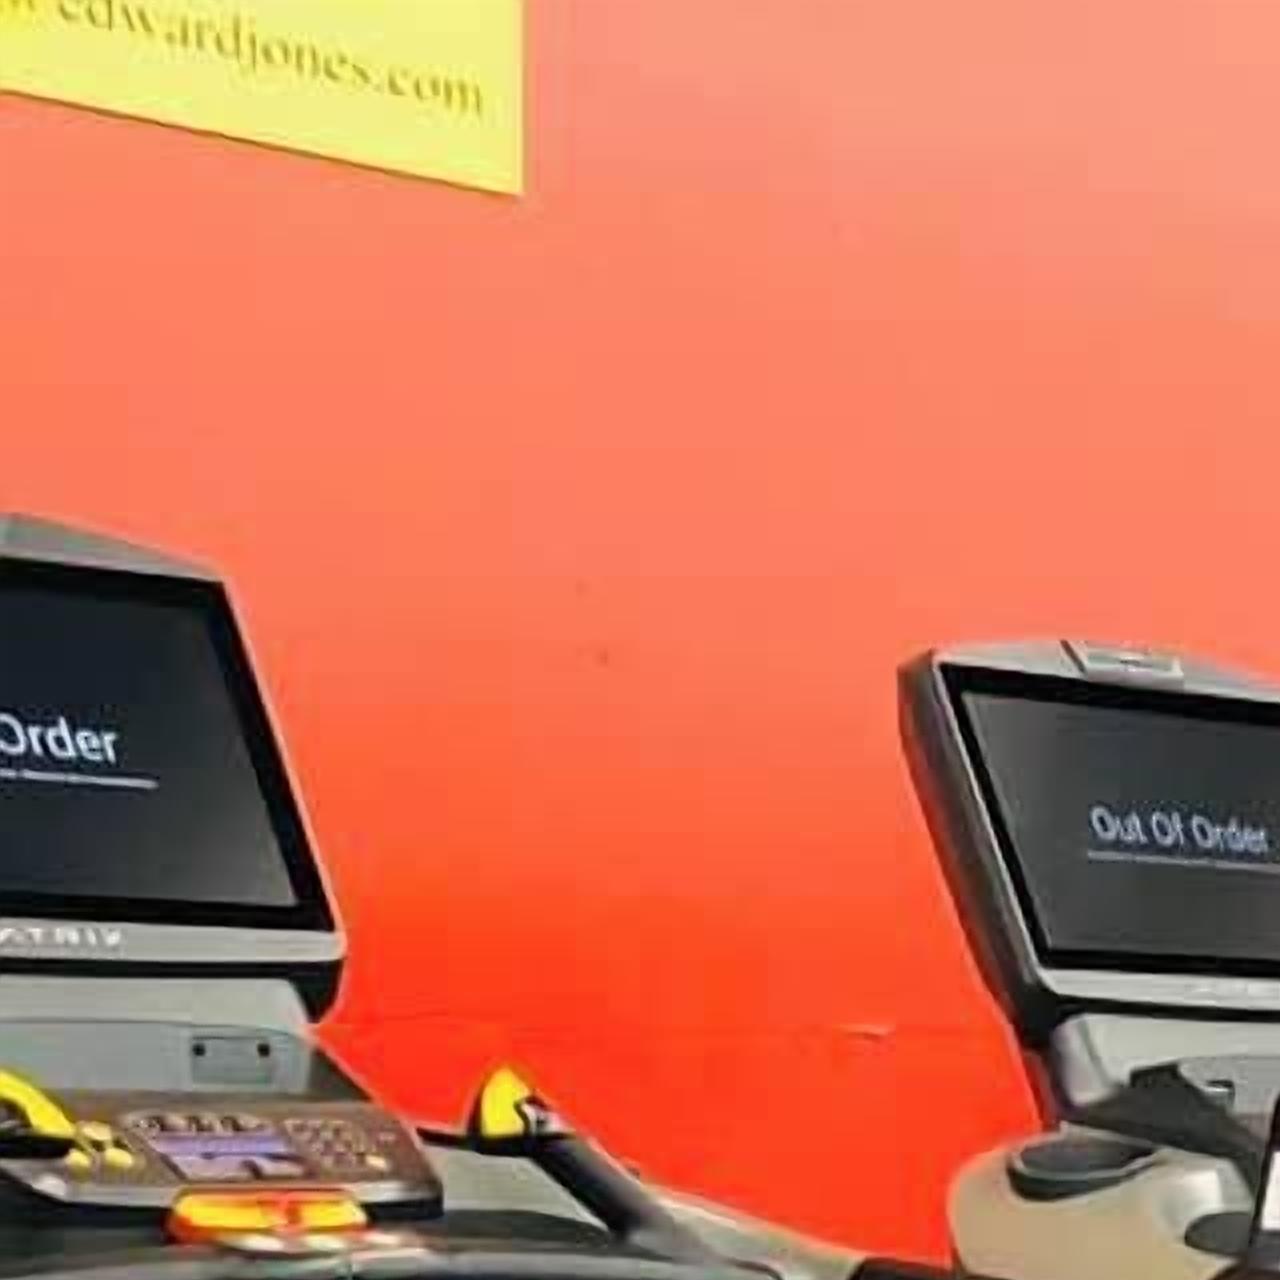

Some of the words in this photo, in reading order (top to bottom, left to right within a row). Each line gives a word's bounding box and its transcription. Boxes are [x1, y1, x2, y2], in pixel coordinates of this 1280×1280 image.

[1091, 806, 1148, 844] Out
[1152, 811, 1184, 846] Of
[1192, 814, 1268, 853] Order
